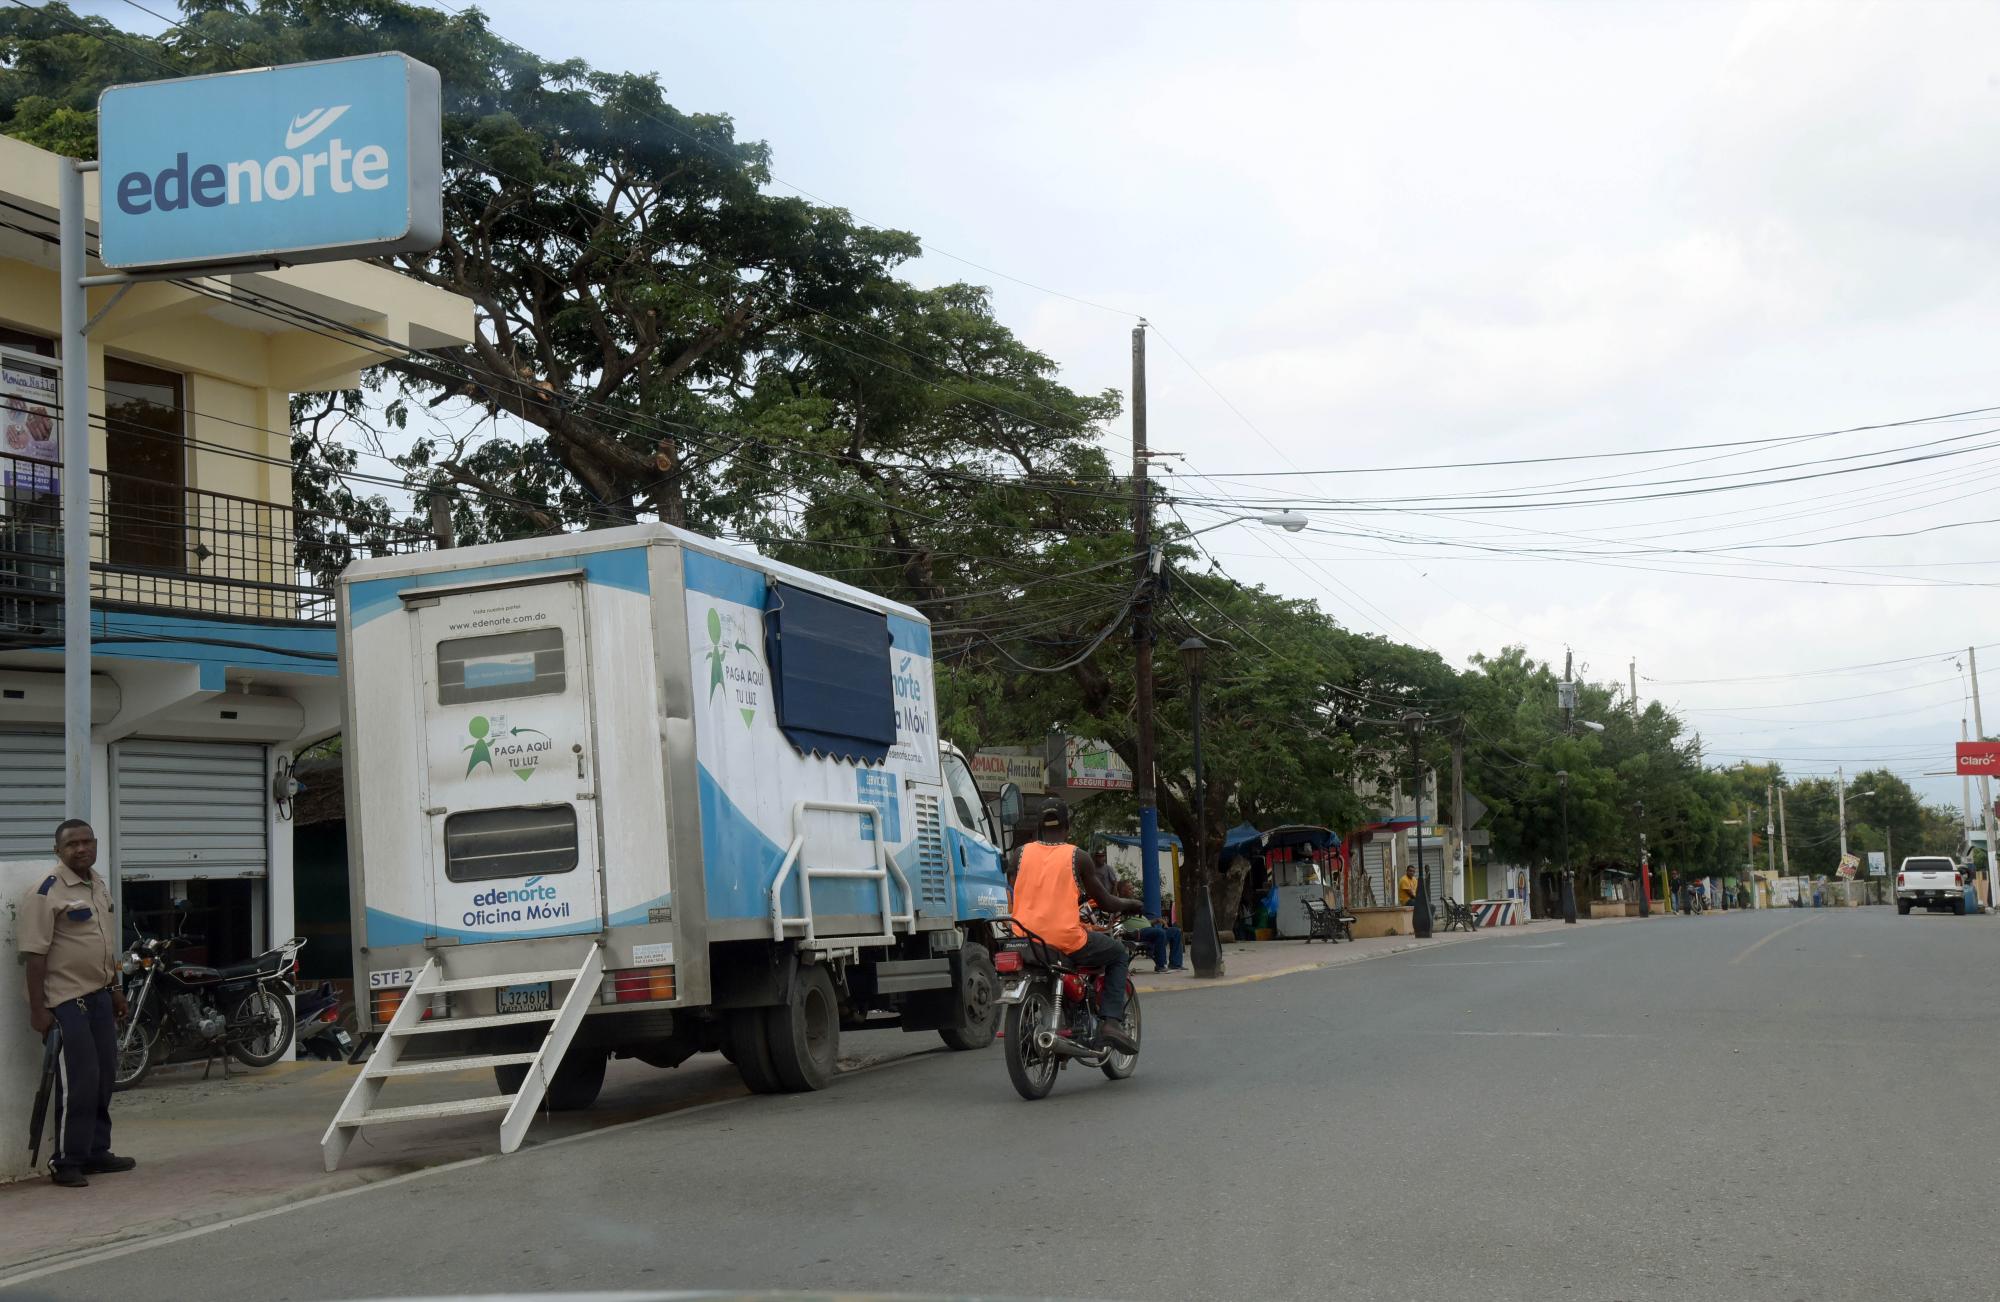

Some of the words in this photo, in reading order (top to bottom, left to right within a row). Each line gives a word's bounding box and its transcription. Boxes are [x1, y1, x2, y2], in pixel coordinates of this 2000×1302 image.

[117, 138, 389, 215] edenorte
[449, 612, 547, 631] www.edenorte.com.do
[725, 664, 746, 682] PAGA
[892, 673, 921, 701] norte
[736, 689, 745, 703] TU
[745, 691, 758, 706] LUZ
[494, 745, 524, 757] PAGA
[526, 738, 552, 753] AQUÍ
[508, 758, 520, 768] TU
[521, 755, 539, 767] LUZ
[971, 755, 1006, 774] RMACIA
[1006, 758, 1041, 778] Amistad
[1960, 755, 1991, 766] Claro
[1073, 778, 1105, 787] ASEGURE
[473, 884, 557, 907] edenorte
[463, 908, 521, 927] Oficina
[526, 902, 570, 921] Móvil
[371, 971, 400, 986] STF
[508, 989, 547, 1005] 323619
